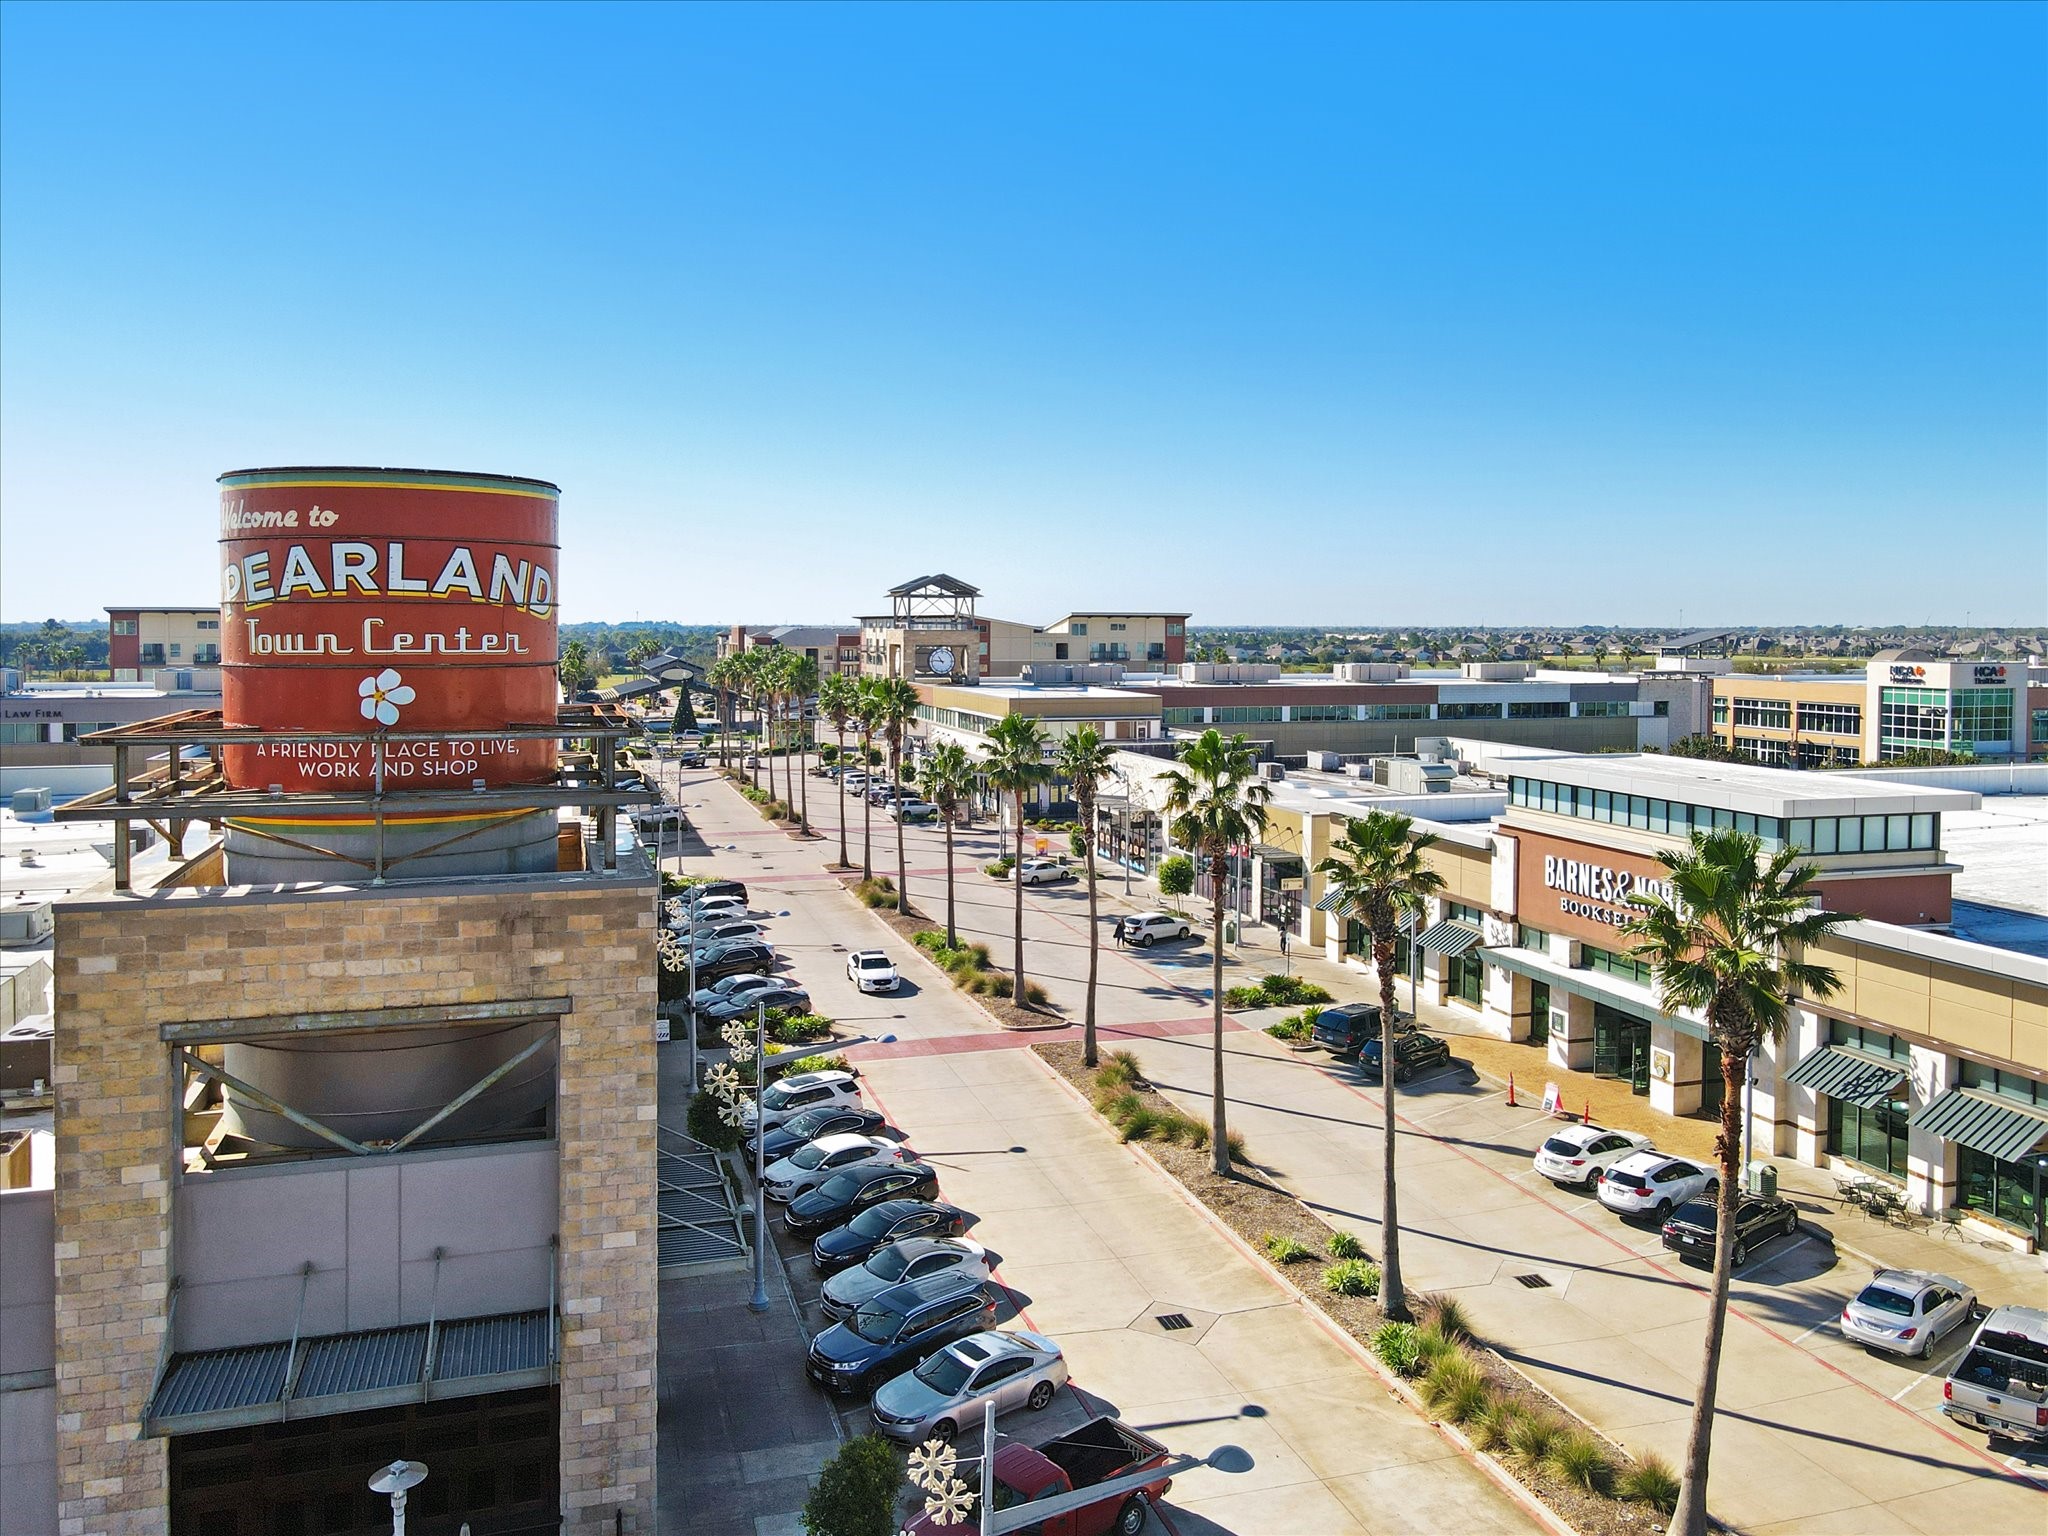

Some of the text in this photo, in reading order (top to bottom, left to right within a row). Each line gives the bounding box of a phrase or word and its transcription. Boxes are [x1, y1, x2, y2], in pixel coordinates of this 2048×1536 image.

[222, 498, 339, 530] Welcome to
[224, 541, 553, 619] PEARLAND
[245, 616, 529, 656] Town Center
[1890, 666, 1916, 676] HCA
[1974, 666, 1998, 677] HCA
[257, 746, 266, 757] A
[271, 742, 362, 759] FRIENDLY
[448, 742, 475, 756] TO
[481, 739, 520, 756] LIVE,
[298, 761, 361, 777] WORK
[422, 760, 478, 776] SHOP
